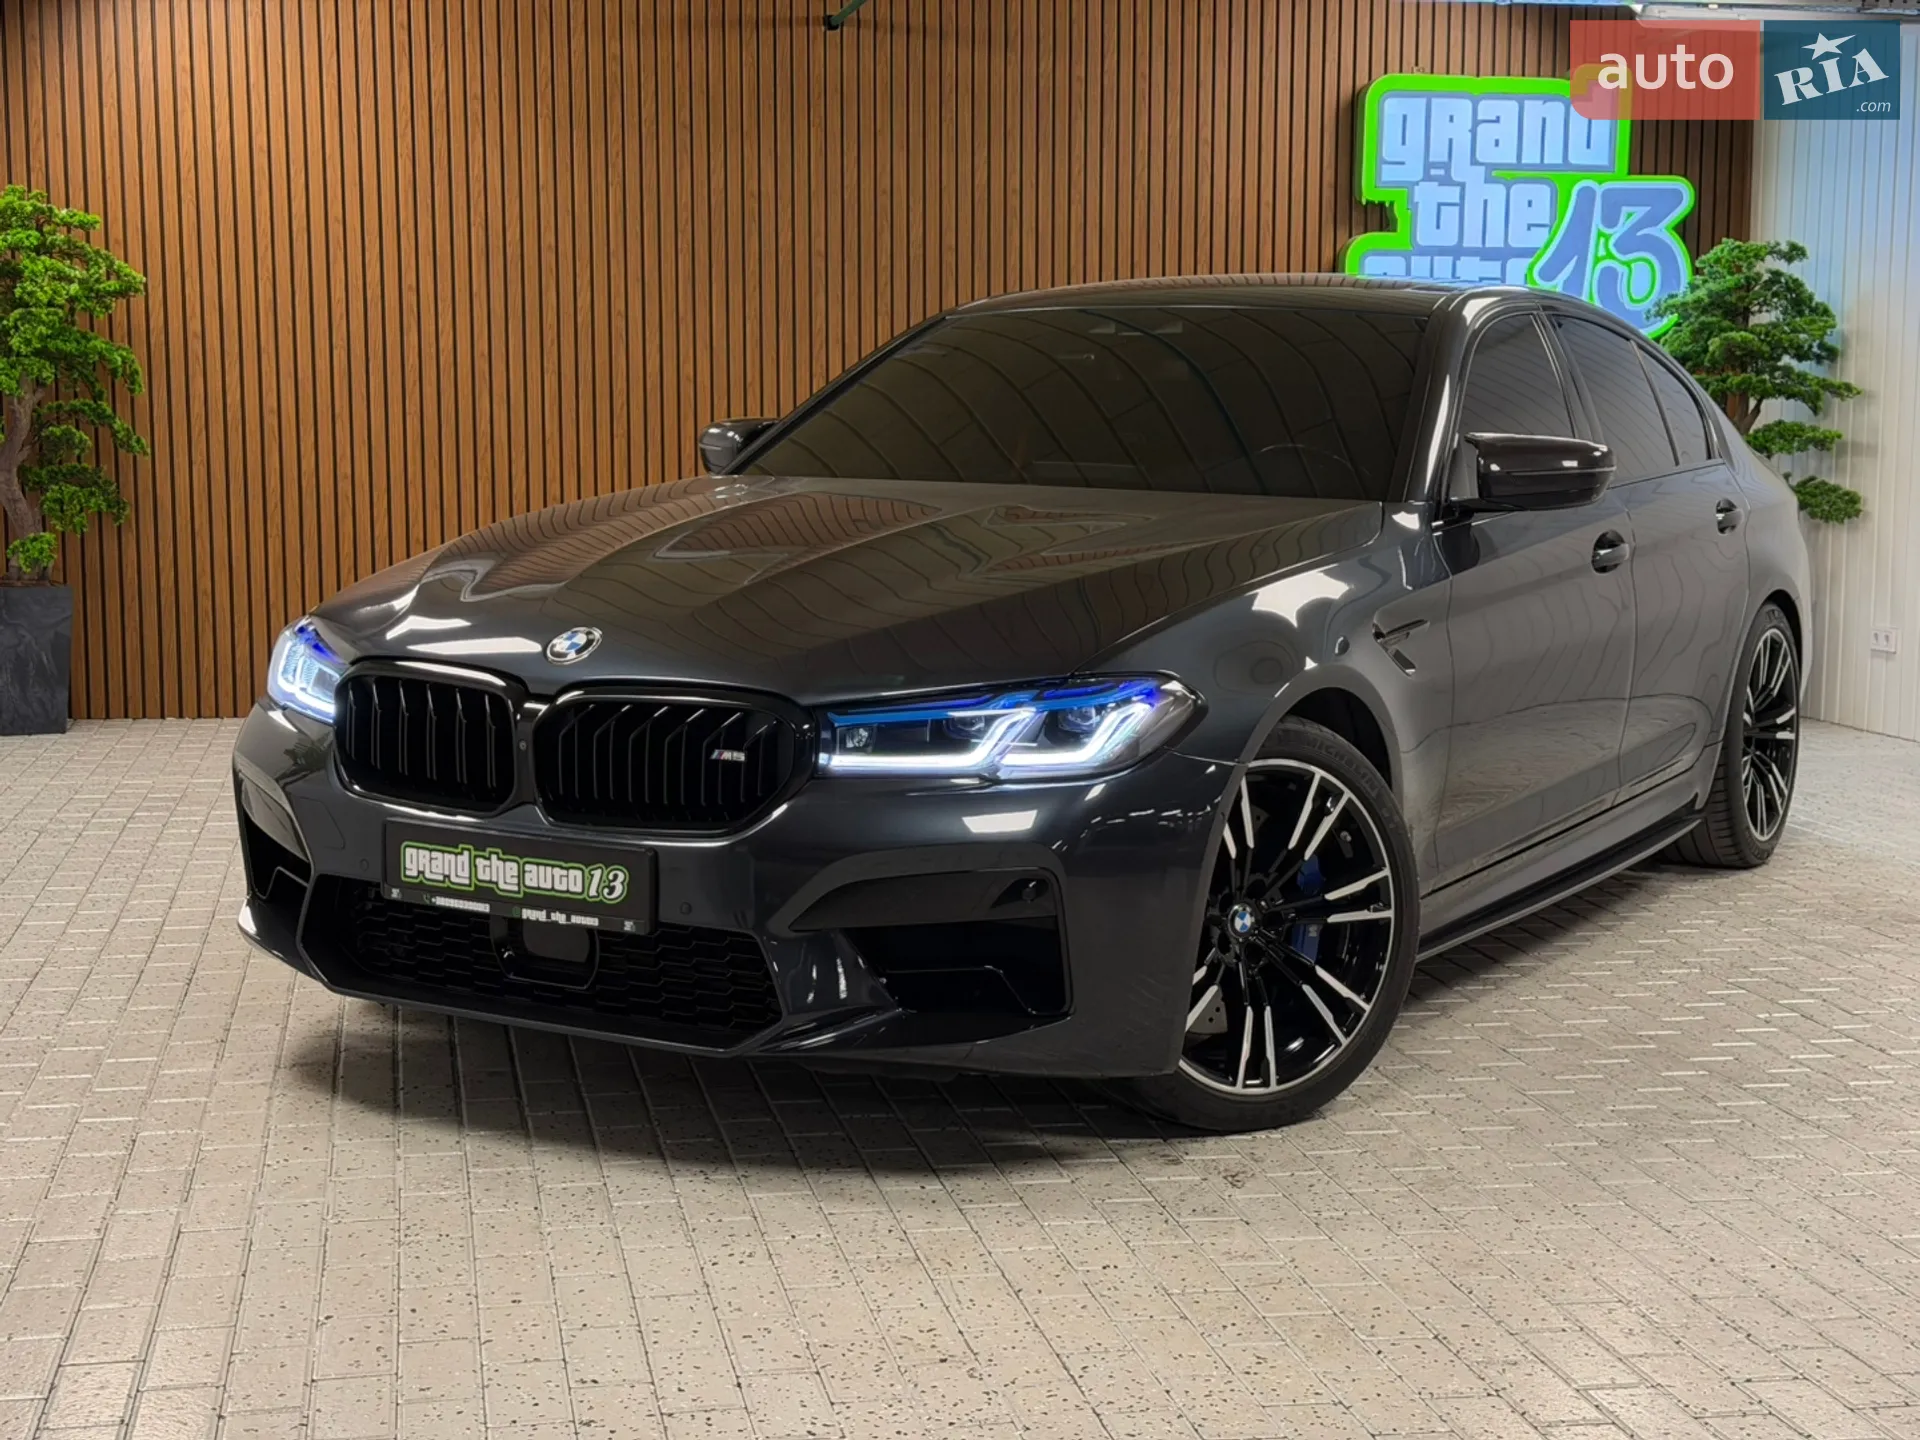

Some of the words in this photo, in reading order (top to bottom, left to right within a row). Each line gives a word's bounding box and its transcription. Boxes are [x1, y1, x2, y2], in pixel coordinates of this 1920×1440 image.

[1379, 80, 1613, 184] grand
[1413, 168, 1552, 249] the
[1534, 181, 1690, 328] 13
[404, 847, 470, 885] grand
[475, 853, 520, 892] the
[523, 863, 584, 894] auto
[587, 867, 626, 899] 13
